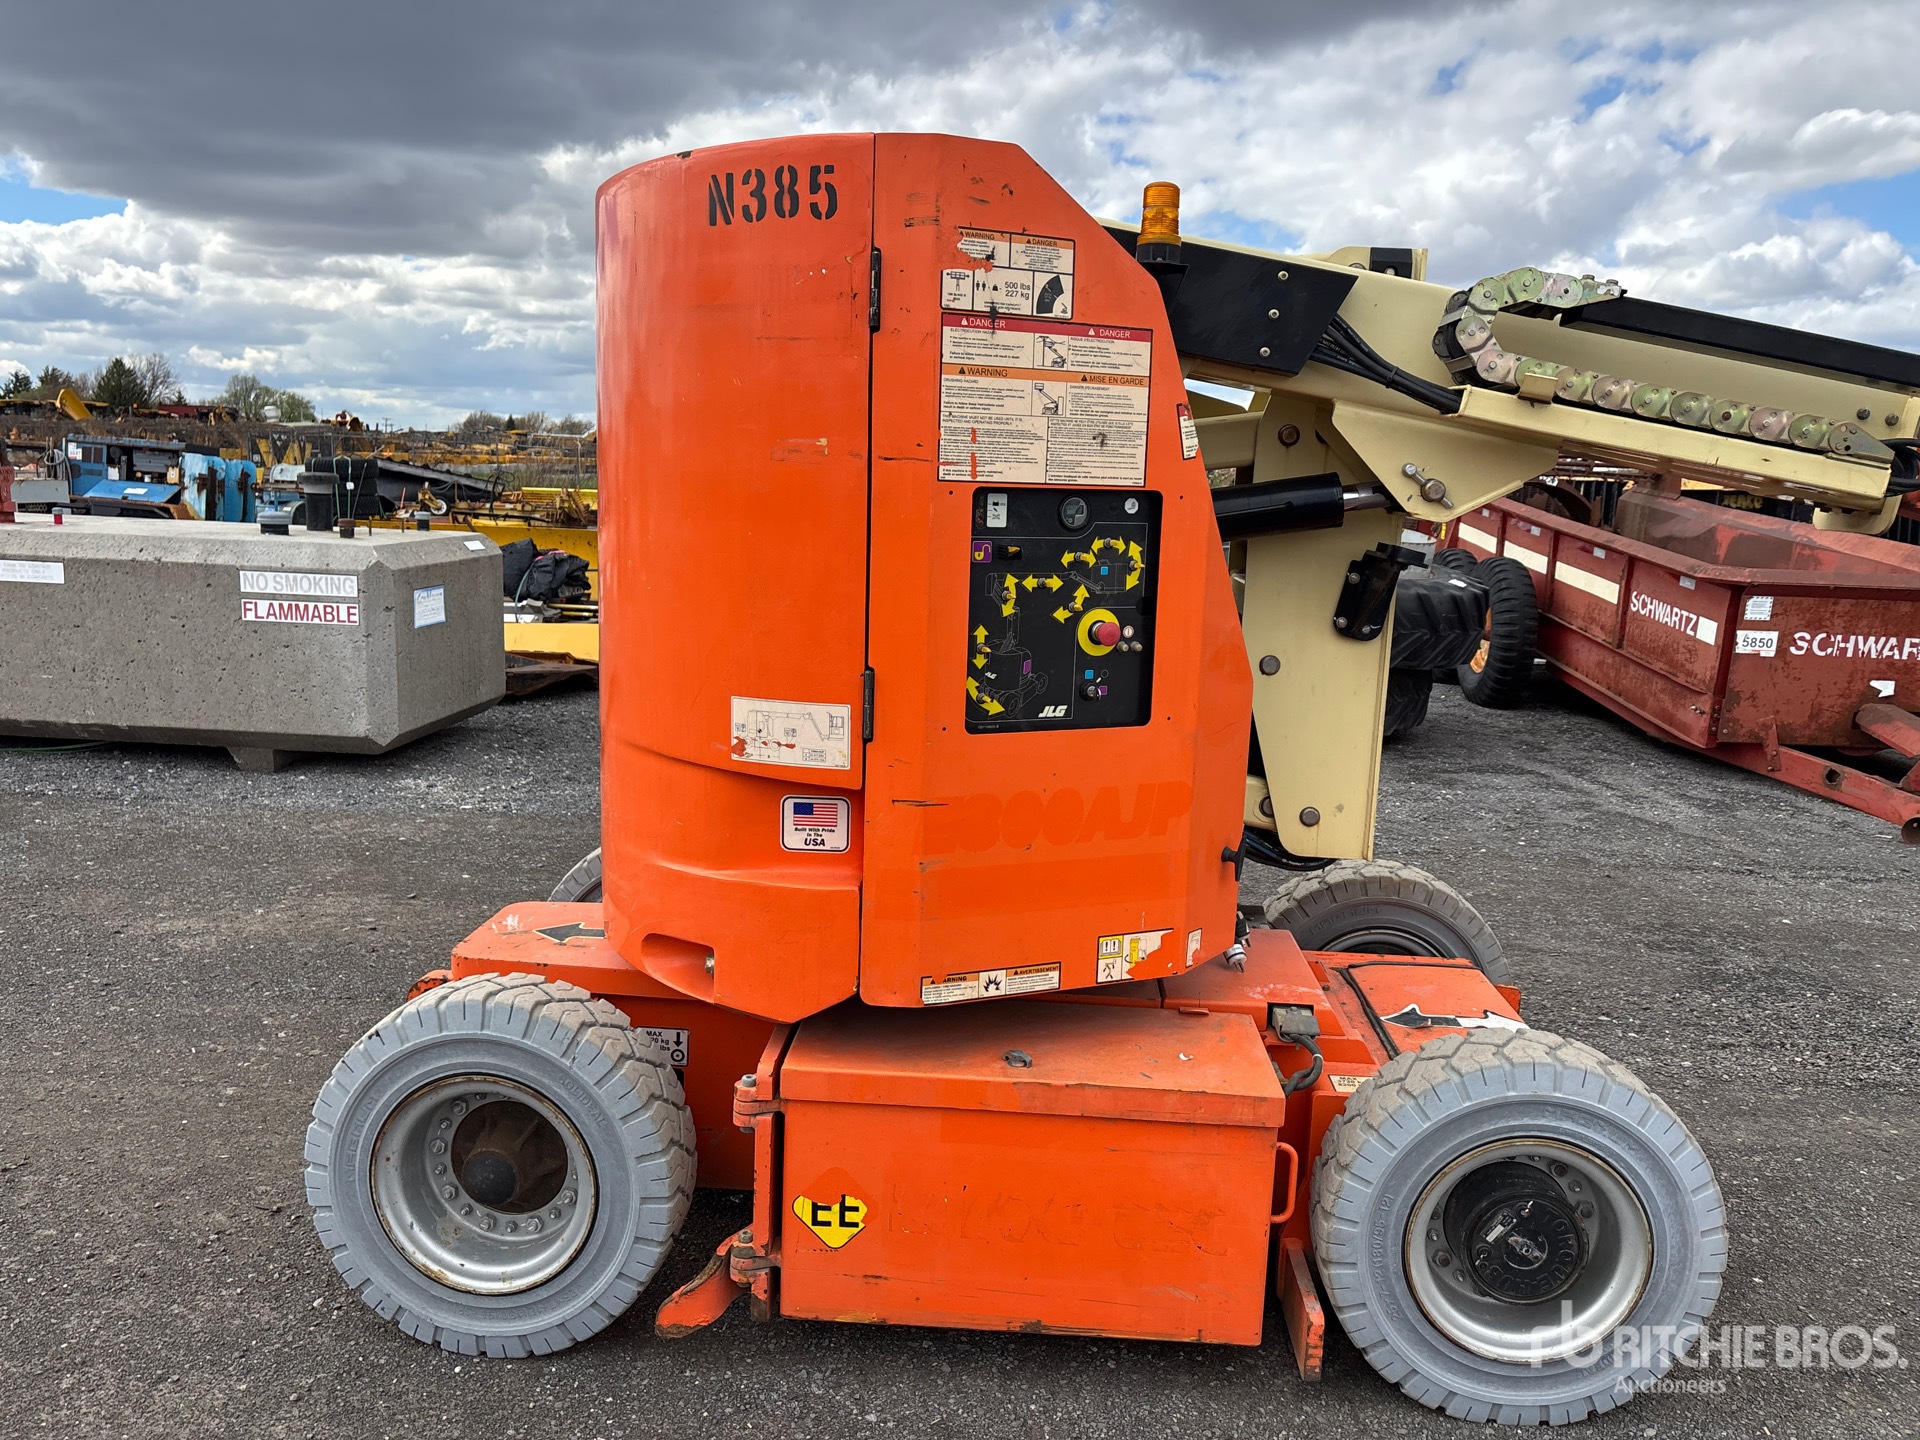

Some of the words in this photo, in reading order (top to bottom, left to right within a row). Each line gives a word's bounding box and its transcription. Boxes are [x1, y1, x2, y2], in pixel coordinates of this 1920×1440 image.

[709, 164, 838, 226] N385
[964, 231, 995, 240] WARNING
[1032, 238, 1058, 247] DANGER
[1020, 282, 1031, 290] lbs
[1020, 290, 1030, 300] kg
[969, 318, 1006, 328] DANGER
[1100, 329, 1131, 338] DANGER
[967, 367, 1008, 377] WARNING
[1090, 375, 1106, 384] MISE
[1108, 376, 1118, 384] EN
[1120, 377, 1144, 386] GARDE
[242, 572, 268, 591] NO
[273, 574, 355, 595] SMOKING
[242, 601, 358, 624] FLAMMABLE
[1630, 591, 1698, 637] SCHWARTZ
[1742, 636, 1773, 648] 5850
[1038, 705, 1068, 717] JLG
[804, 838, 825, 846] USA
